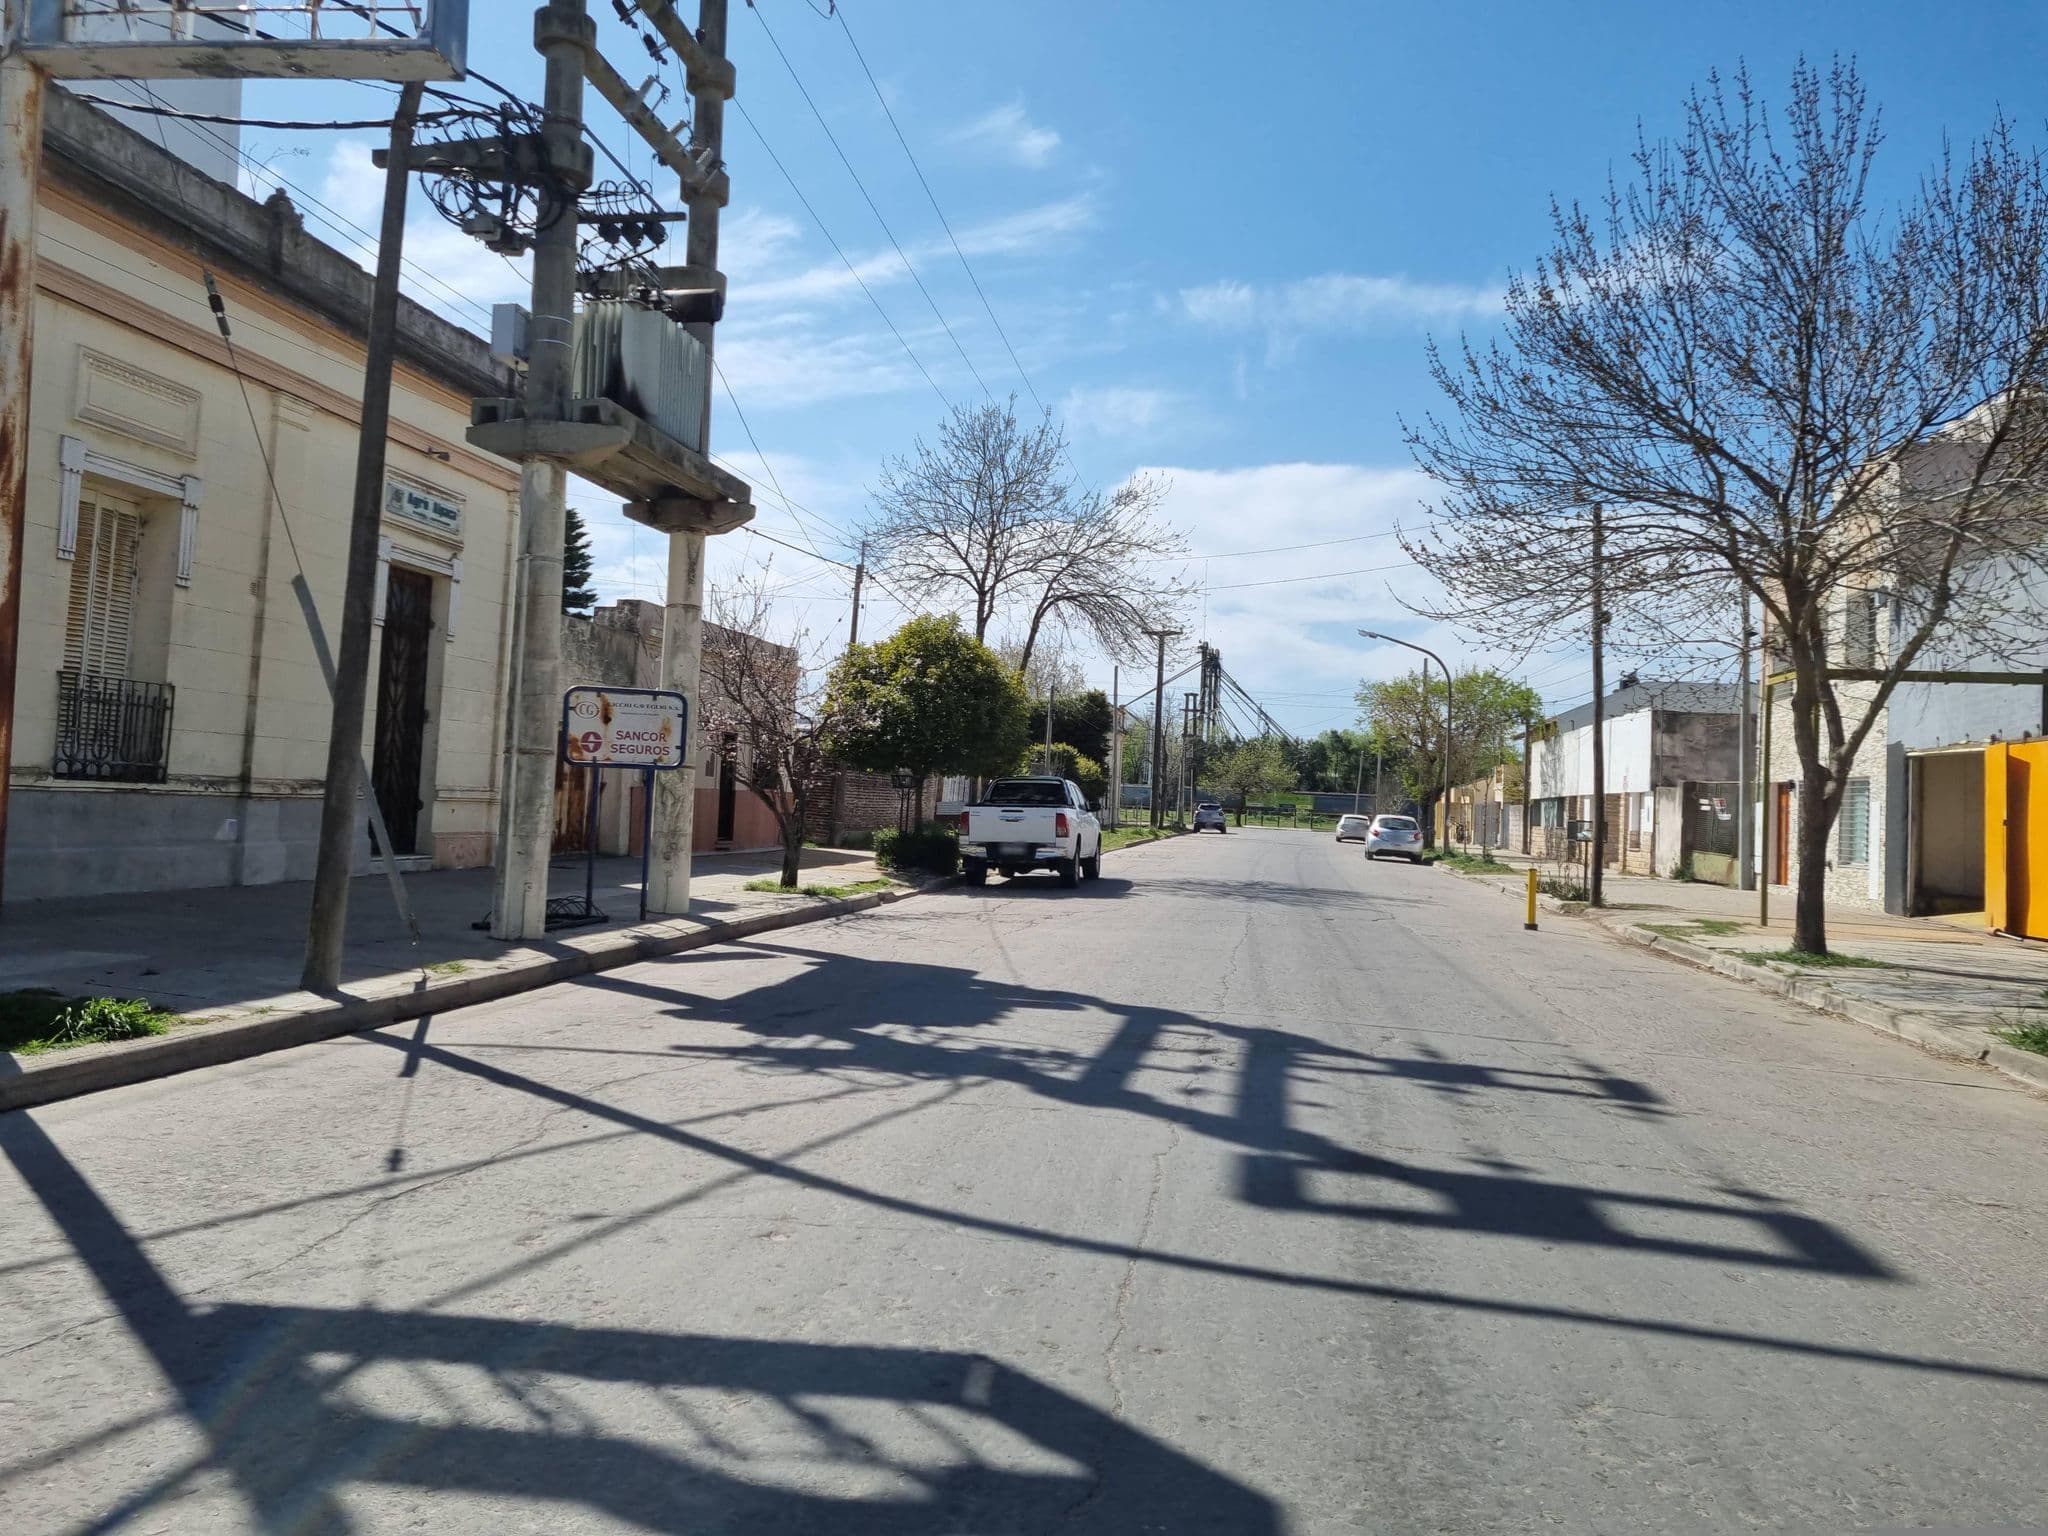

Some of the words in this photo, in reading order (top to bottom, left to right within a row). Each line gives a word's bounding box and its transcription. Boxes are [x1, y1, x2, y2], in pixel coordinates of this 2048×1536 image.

[579, 704, 594, 715] CG
[616, 730, 667, 743] SANCOR
[610, 743, 670, 756] SEGUROS
